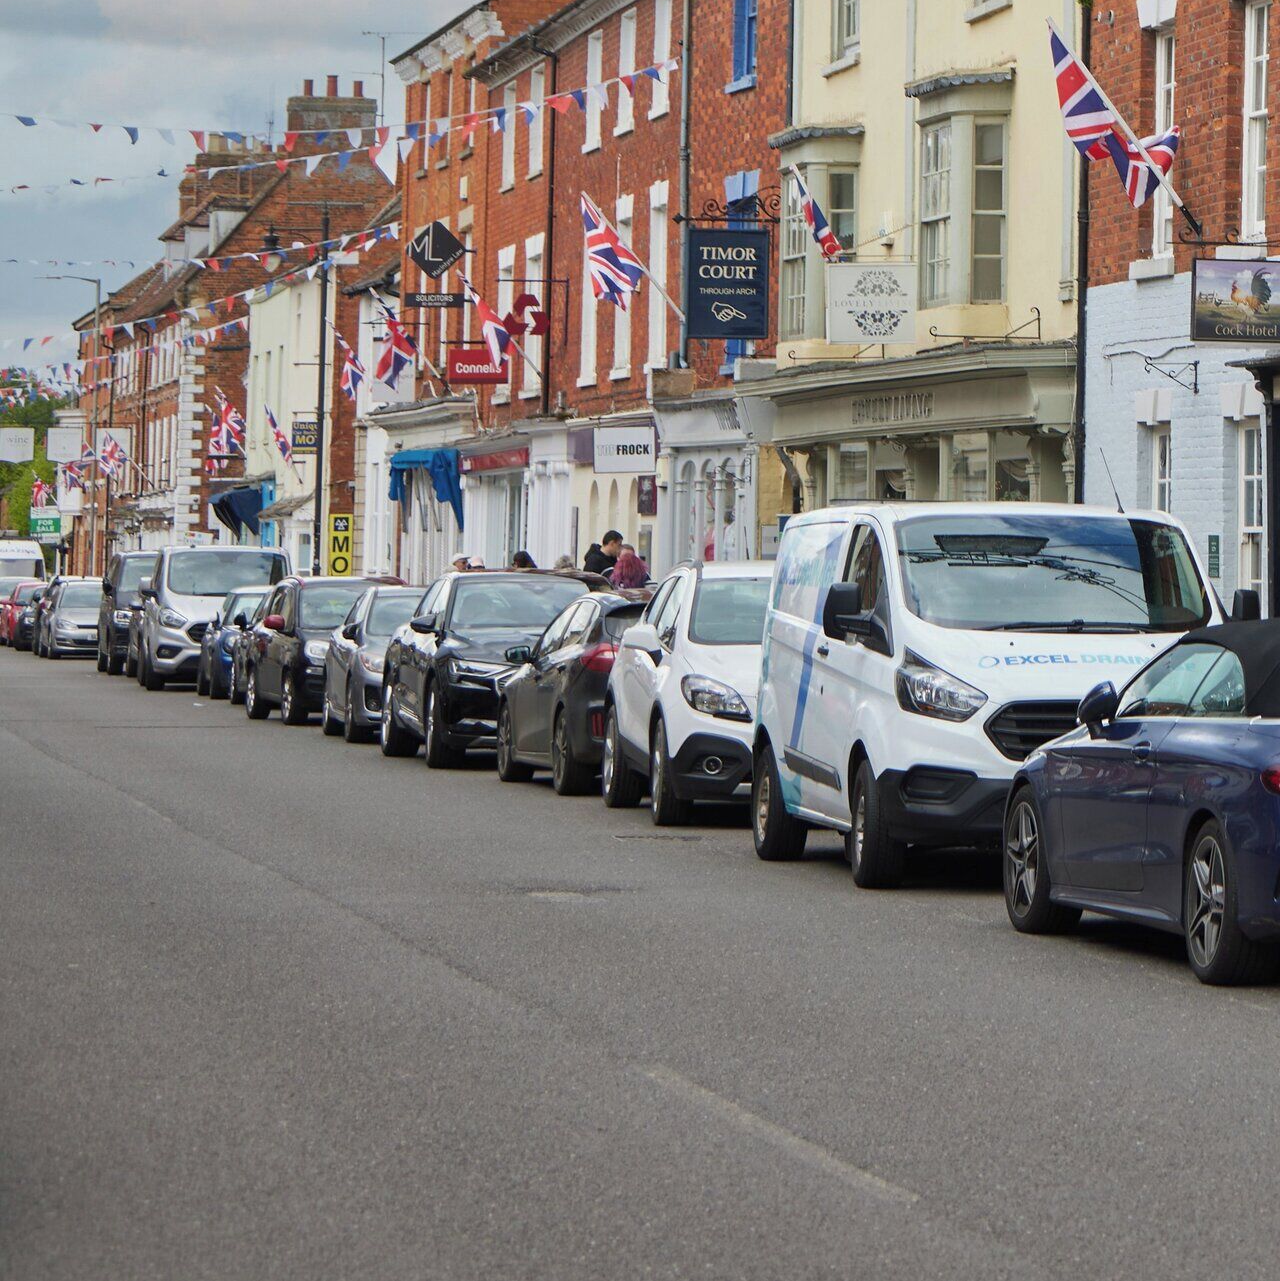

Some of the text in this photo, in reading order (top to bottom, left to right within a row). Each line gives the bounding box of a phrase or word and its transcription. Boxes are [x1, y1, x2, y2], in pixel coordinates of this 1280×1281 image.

[408, 223, 443, 261] ML
[699, 246, 757, 261] TIMOR
[699, 265, 757, 279] COURT
[699, 287, 756, 295] THROUGH ARCH
[1215, 323, 1278, 337] Cock Hotel
[295, 434, 318, 444] MO
[1004, 653, 1078, 666] EXCEL
